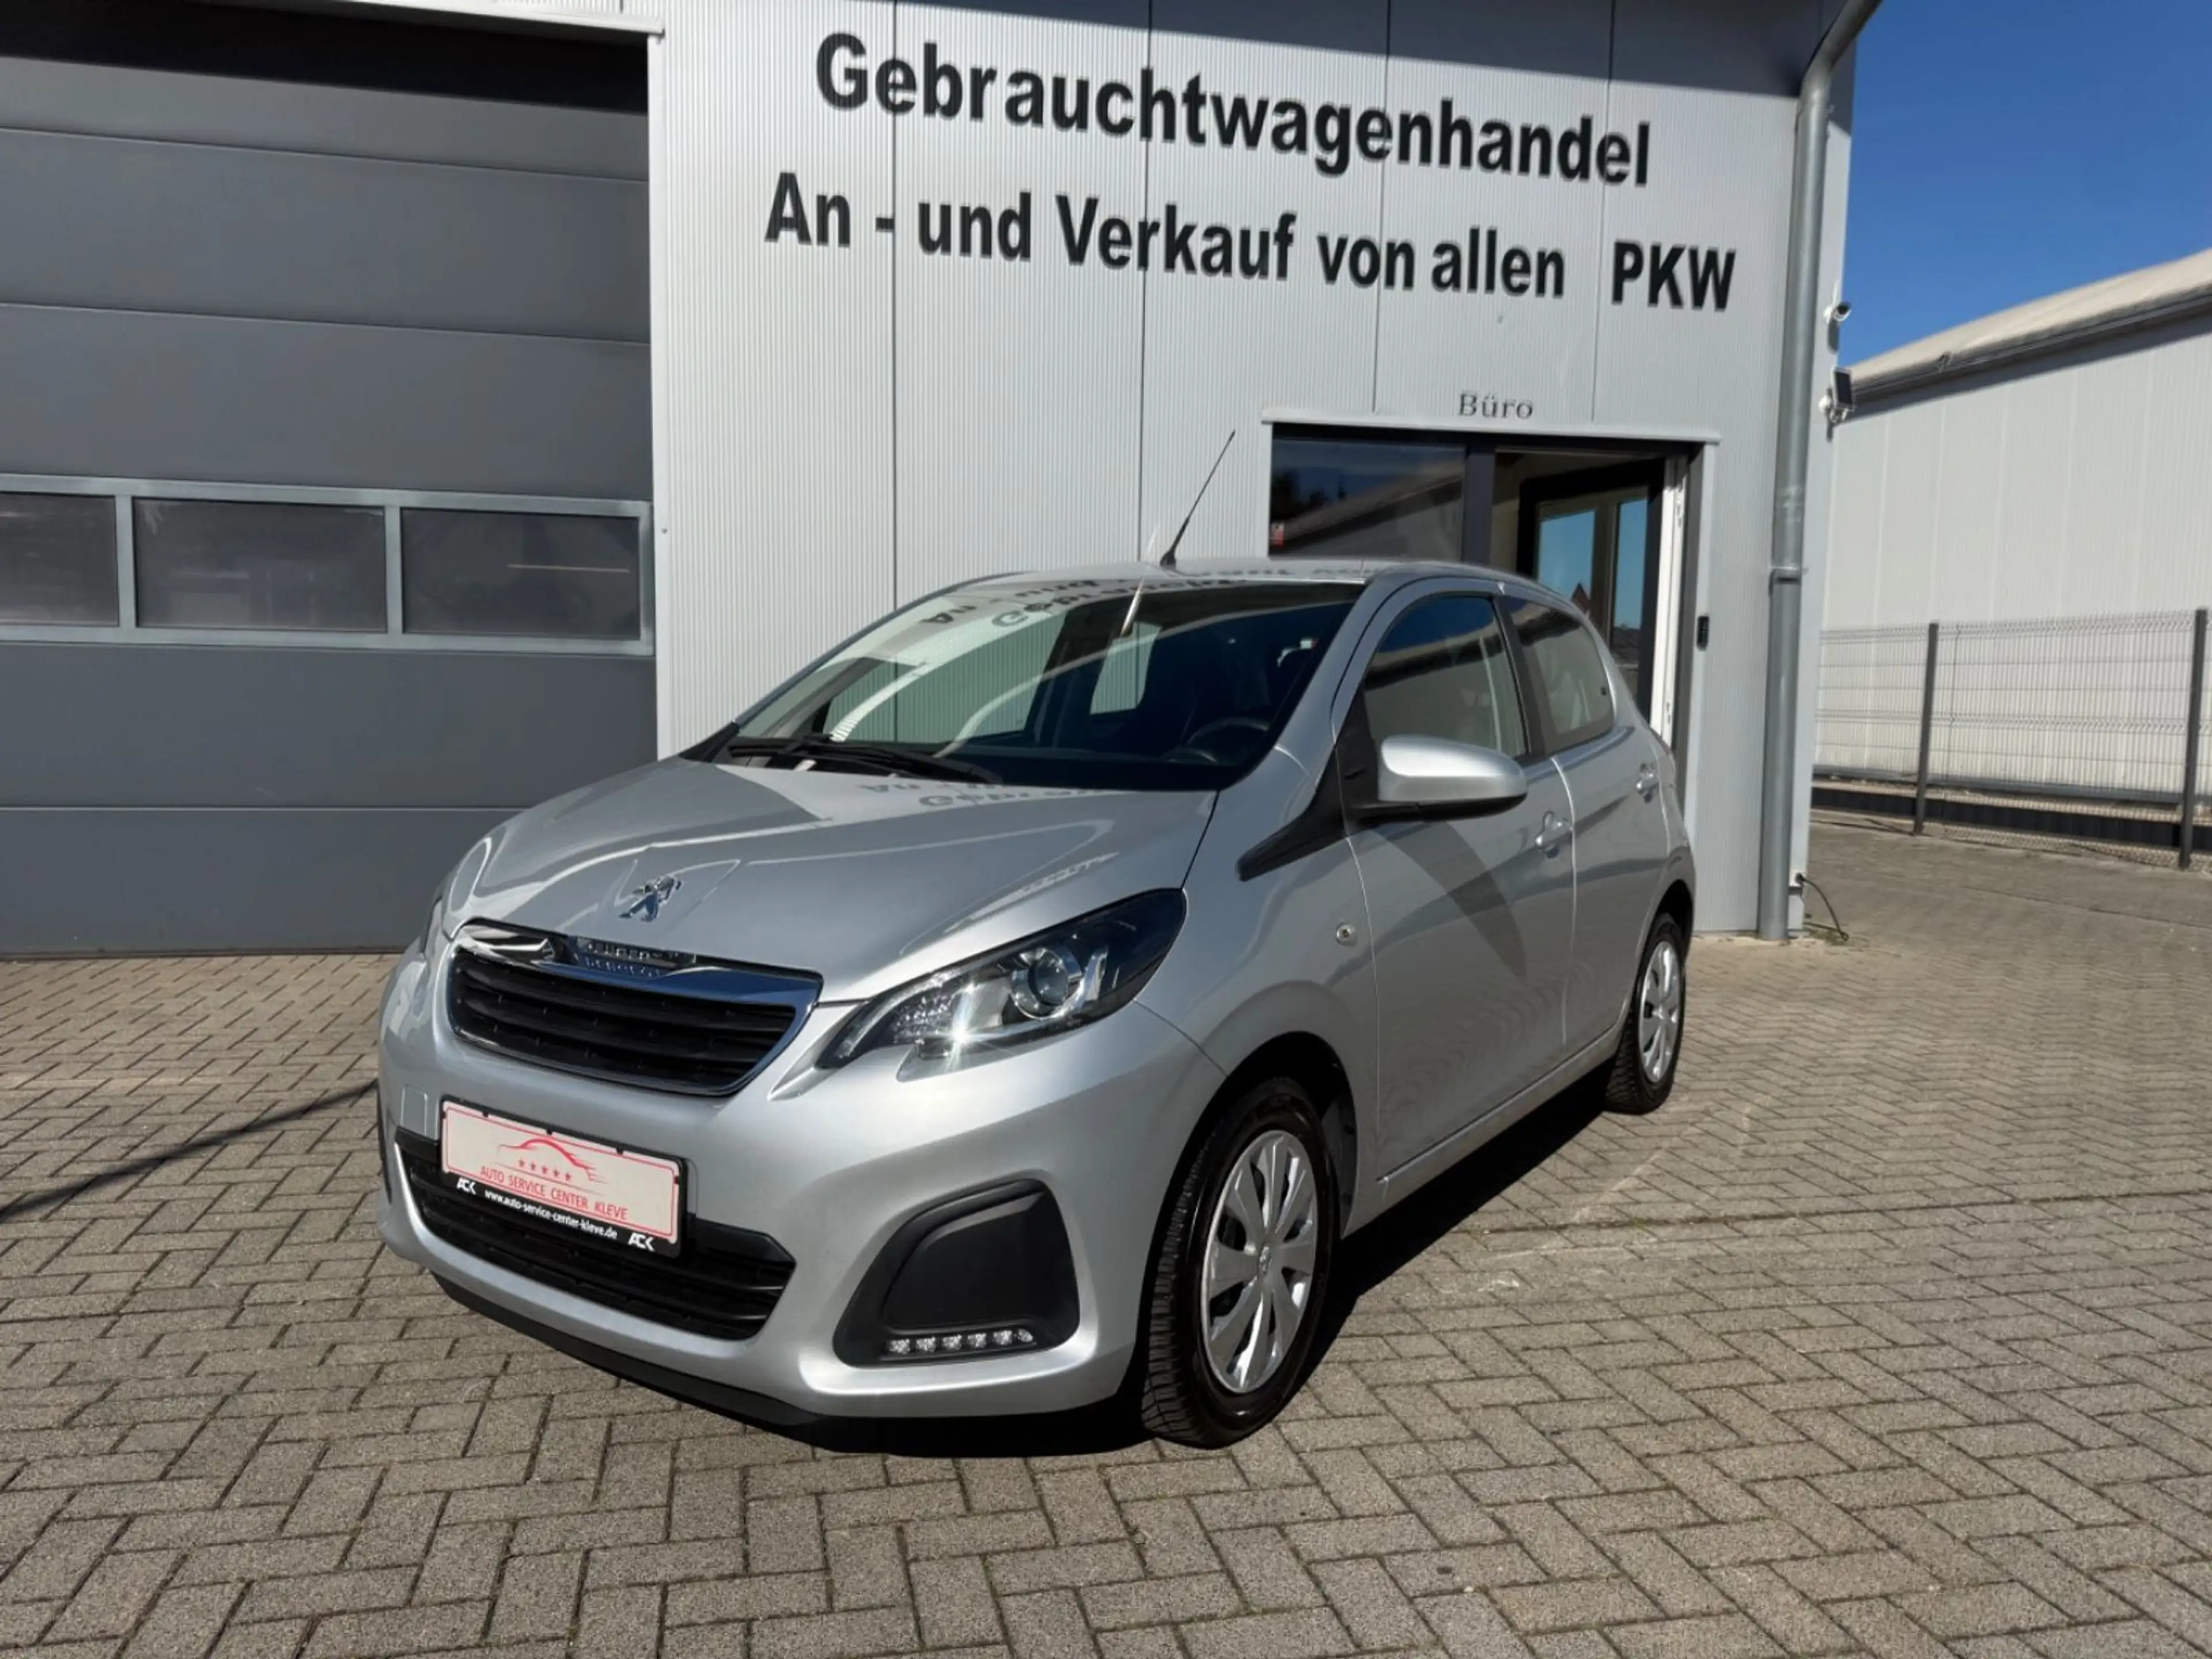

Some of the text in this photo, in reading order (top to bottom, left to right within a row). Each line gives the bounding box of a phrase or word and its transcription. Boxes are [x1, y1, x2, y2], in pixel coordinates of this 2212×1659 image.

[816, 32, 1650, 185] Gebrauchtwagenhandel
[765, 172, 851, 246] An
[918, 191, 1032, 260] und
[1055, 195, 1297, 279] Verkauf
[1316, 233, 1415, 290] von
[1431, 227, 1565, 297] allen
[1611, 241, 1736, 312] PKW
[1459, 392, 1533, 419] Büro
[480, 1165, 628, 1220] AUTO SERVICE CENTER KLEVE
